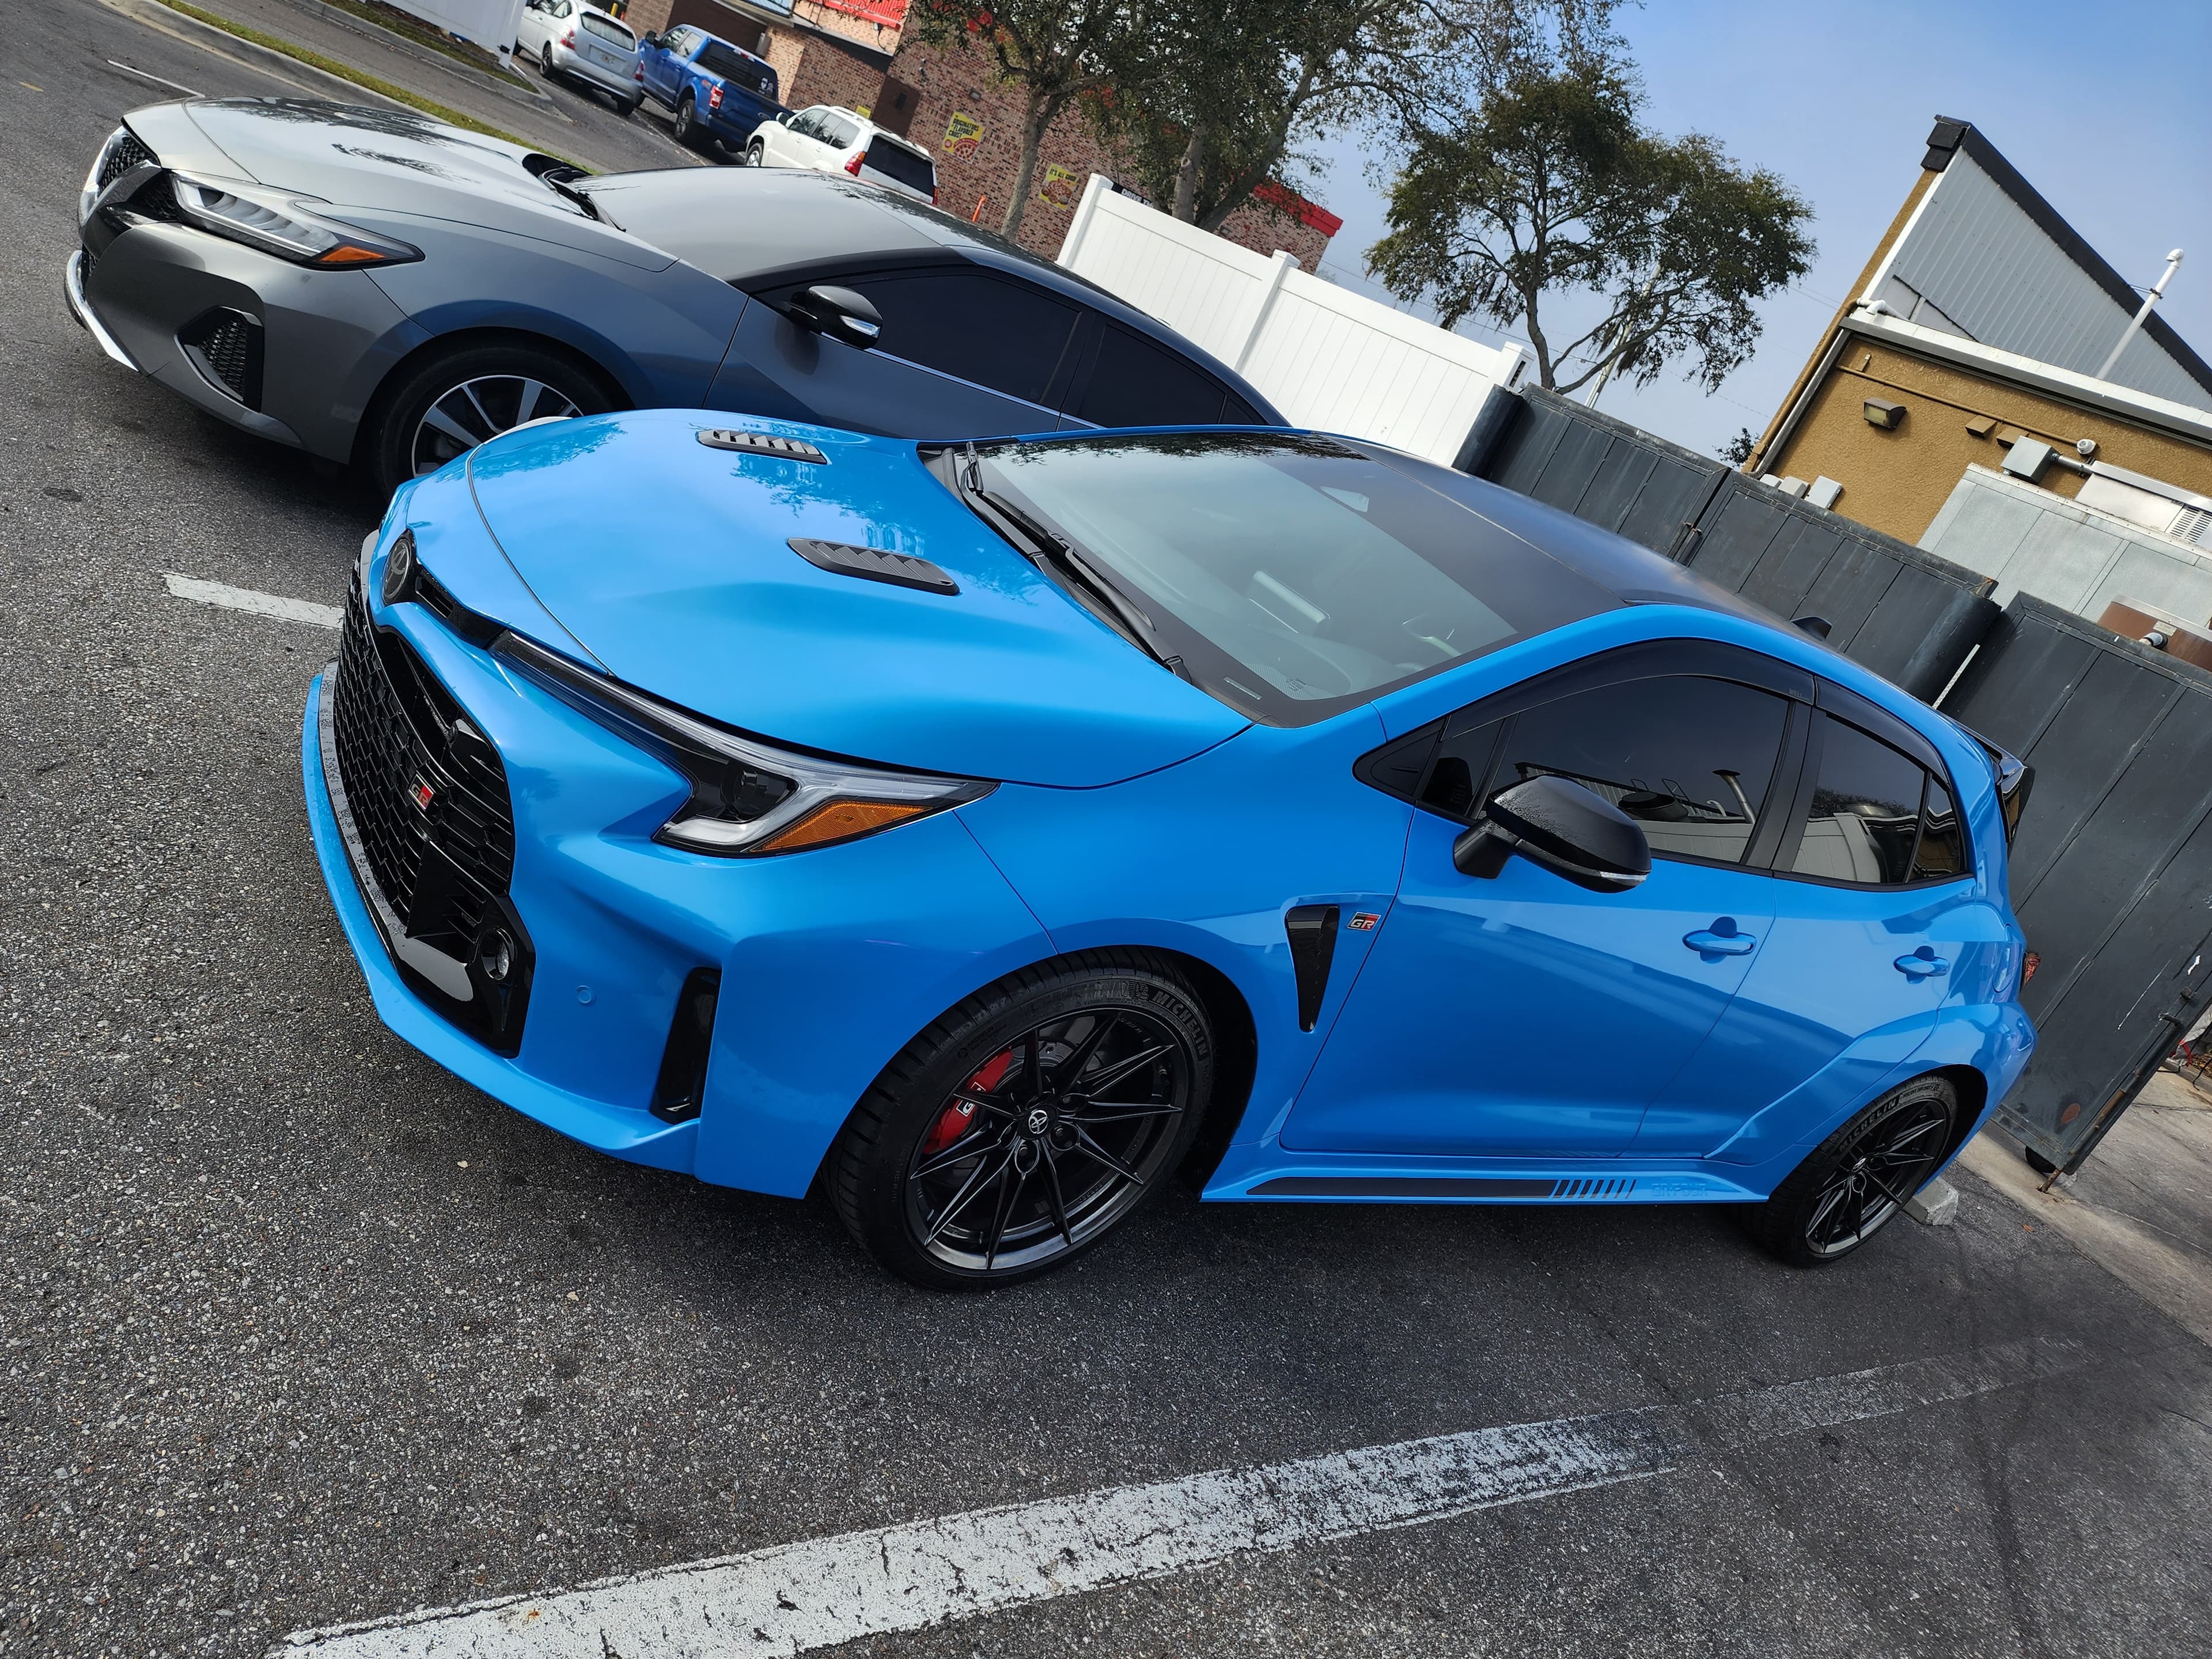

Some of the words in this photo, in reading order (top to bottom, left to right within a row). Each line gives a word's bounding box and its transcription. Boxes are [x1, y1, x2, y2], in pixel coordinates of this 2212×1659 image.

[953, 118, 979, 131] ORIGINATORS
[953, 124, 973, 136] FLAVORED
[949, 130, 962, 138] CRUST
[1050, 168, 1058, 176] IT'S
[1121, 188, 1142, 202] DRIVE
[411, 783, 429, 807] GR
[1350, 919, 1375, 929] GR
[1153, 991, 1207, 1056] MICHELIN
[1839, 1099, 1896, 1152] MICHELIN
